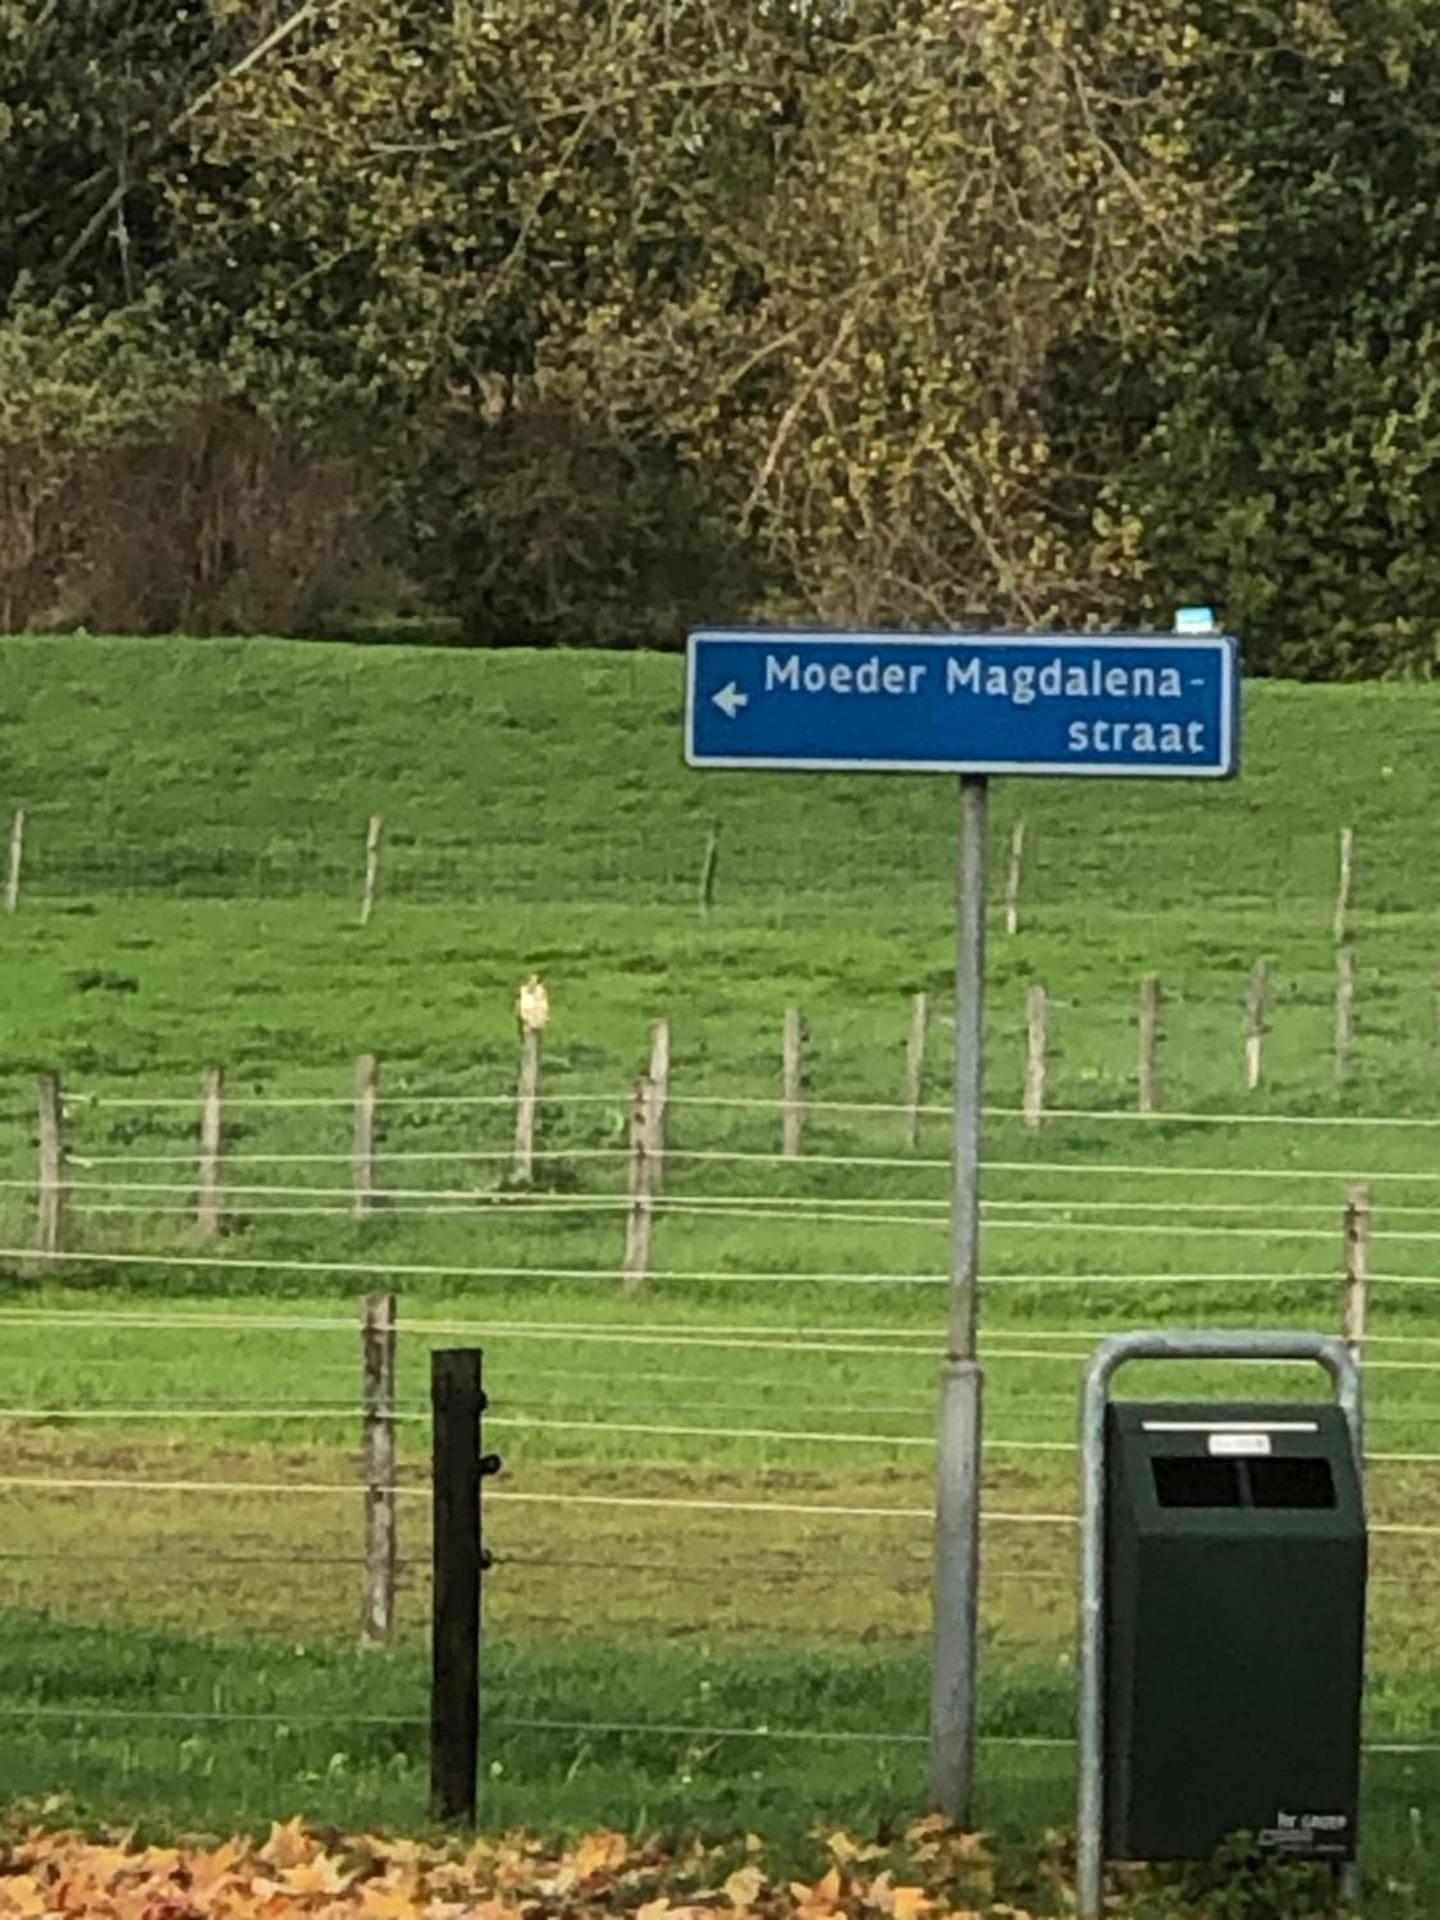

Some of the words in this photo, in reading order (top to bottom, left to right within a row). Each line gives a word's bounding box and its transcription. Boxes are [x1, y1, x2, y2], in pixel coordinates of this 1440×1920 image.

[765, 655, 925, 693] Moeder
[946, 658, 1205, 704] Magdalena-
[1068, 718, 1205, 753] straat
